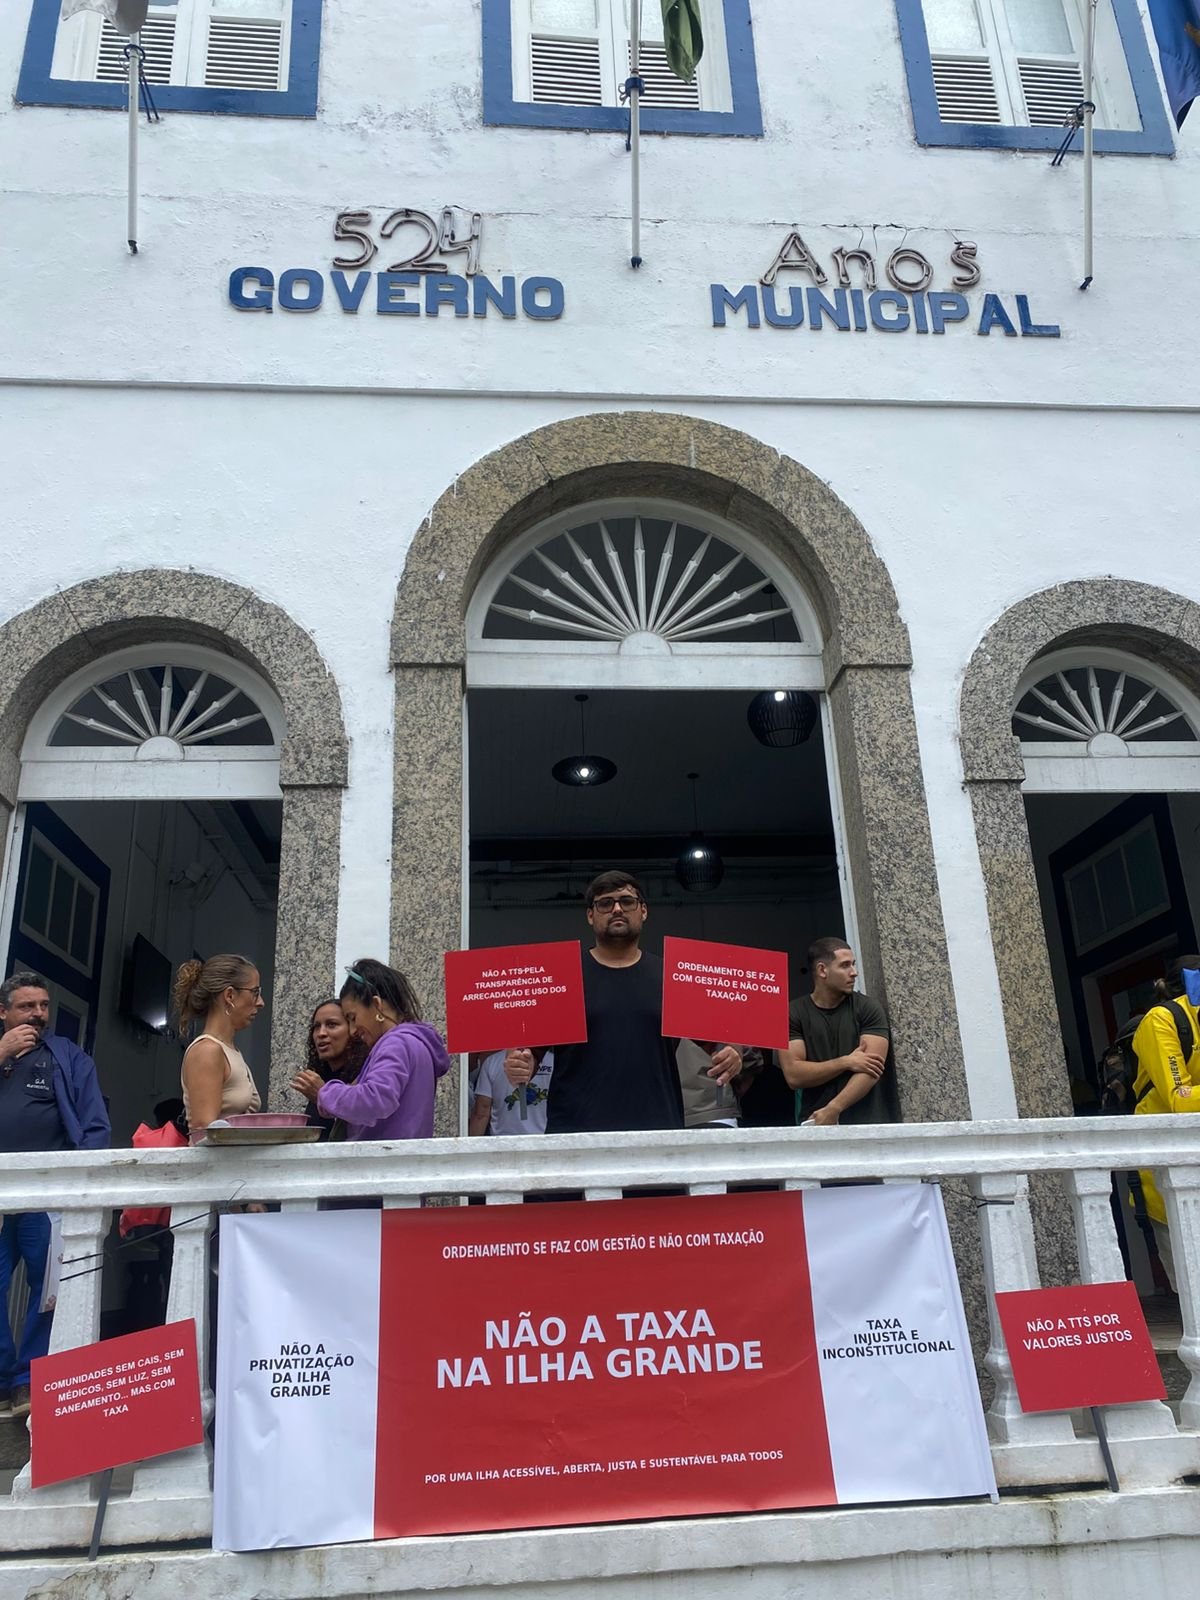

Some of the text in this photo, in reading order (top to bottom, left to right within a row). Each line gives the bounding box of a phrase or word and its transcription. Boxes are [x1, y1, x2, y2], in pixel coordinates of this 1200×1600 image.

[333, 208, 981, 292] 524 Anos
[229, 267, 1060, 337] GOVERNO MUNICIPAL
[482, 969, 499, 978] NÃO
[678, 961, 776, 982] ORDENAMENTO SE FAZ
[463, 985, 567, 1001] ARRECADAÇÃO E USO DOS
[475, 977, 541, 989] TRANSPARÊNCIA
[672, 973, 692, 982] COM
[695, 976, 730, 988] GESTÃO
[740, 981, 758, 991] NÃO
[760, 985, 780, 994] COM
[493, 999, 537, 1009] RECURSOS
[706, 989, 748, 1002] TAXAÇÃO
[442, 1228, 764, 1259] ORDENAMENTO SE FAZ COM GESTÃO E NÃO COM TAXAÇÃO
[485, 1308, 716, 1349] NÃO A TAXA
[866, 1318, 902, 1330] TAXA
[1026, 1313, 1121, 1333] NÃO A TTS POR
[853, 1329, 920, 1346] INJUSTA E
[1022, 1329, 1133, 1350] VALORES JUSTOS
[280, 1341, 326, 1356] NÃO A
[822, 1340, 956, 1360] INCONSTITUCIONAL
[43, 1348, 184, 1392] COMUNIDADES SEM CAIS, SEM
[249, 1353, 354, 1371] PRIVATIZAÇÃO
[436, 1340, 764, 1389] NA ILHA GRANDE
[58, 1365, 172, 1403] MÉDICOS, SEM LUZ, SEM
[272, 1370, 331, 1384] DA ILHA
[270, 1384, 331, 1398] GRANDE
[55, 1392, 128, 1417] SANEAMENTO...
[103, 1404, 129, 1417] TAXA
[424, 1450, 783, 1484] POR UMA ILHA ACESSÍVEL, ABERTA, JUSTA E SUSTENTÁVEL PARA TODOS
